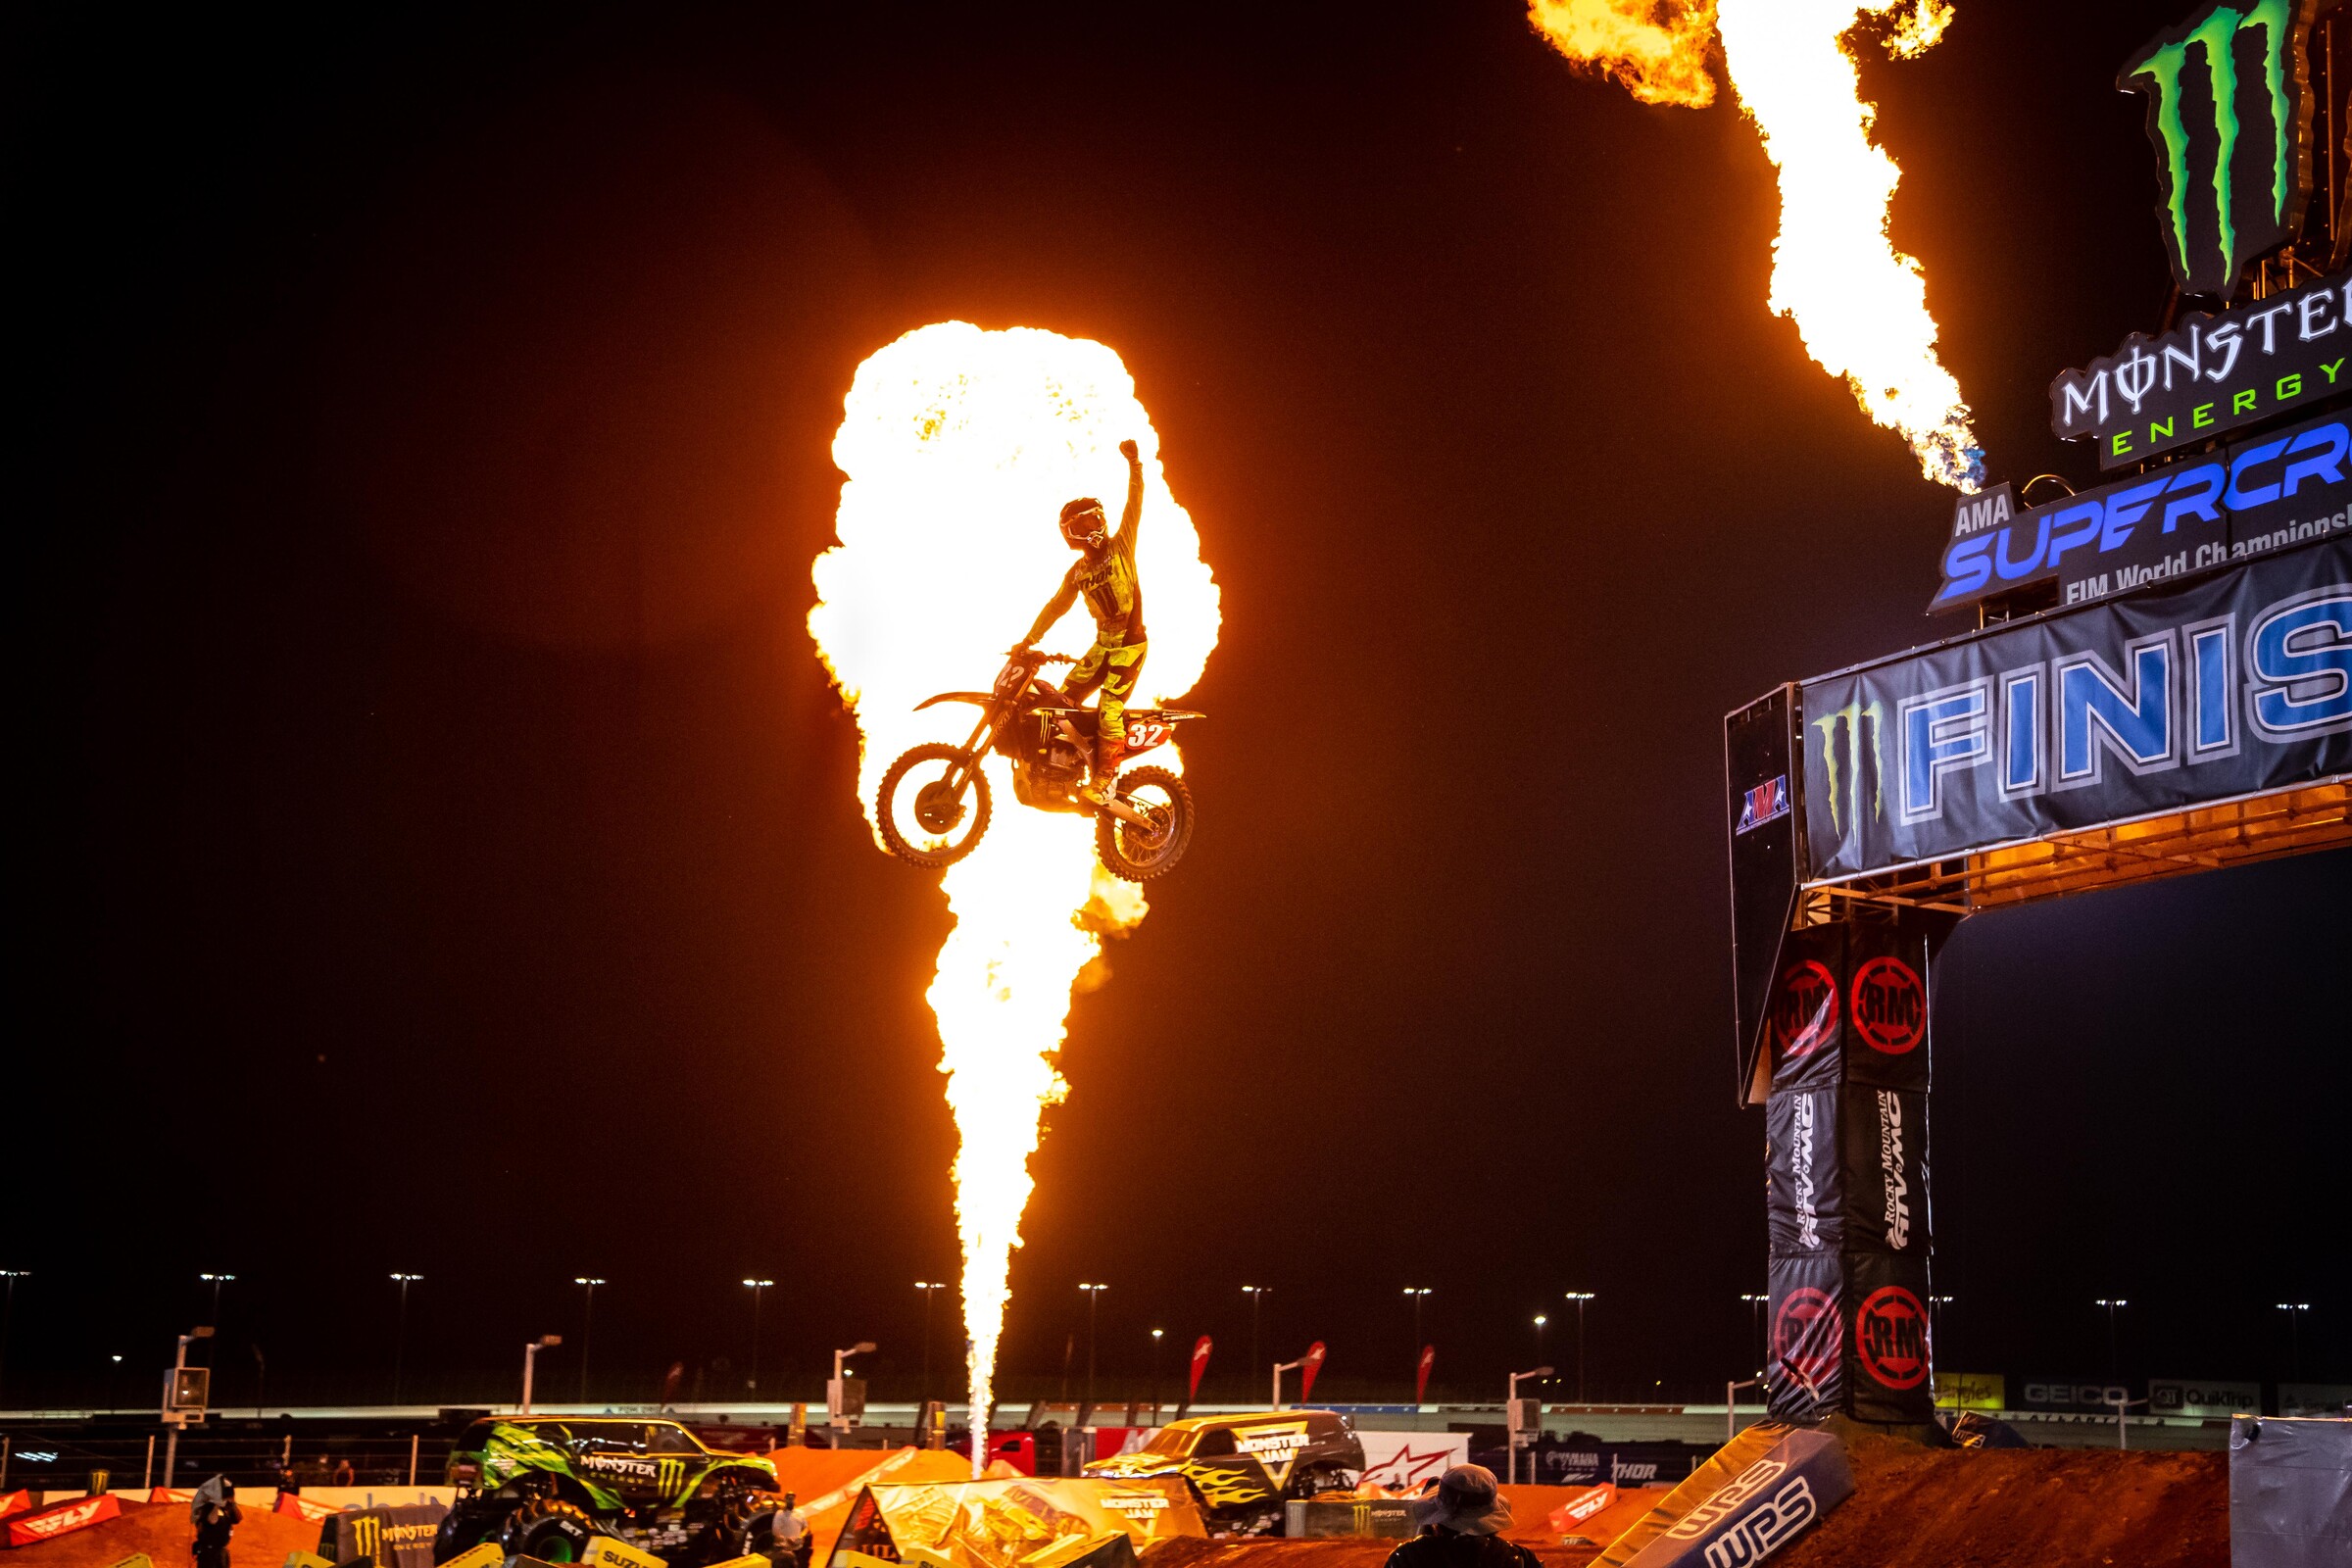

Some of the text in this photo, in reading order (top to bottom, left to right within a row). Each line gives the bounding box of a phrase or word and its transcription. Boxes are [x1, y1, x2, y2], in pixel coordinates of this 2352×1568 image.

[2112, 357, 2346, 457] ENERGY
[1936, 421, 2352, 601] SUPERCR
[1955, 493, 2010, 536] AMA
[1078, 564, 1113, 589] THOR
[2067, 573, 2109, 605] FIM
[2115, 550, 2187, 590] World
[1897, 582, 2352, 827] FINIS
[1127, 723, 1164, 748] 32
[1736, 774, 1789, 832] AMA
[1791, 1094, 1806, 1225] ROCKY MOUNTAIN
[1877, 1089, 1895, 1224] ROCKY MOUNTAIN
[2024, 1383, 2129, 1405] GEICO
[2185, 1389, 2254, 1409] QuikTrip
[1234, 1434, 1310, 1454] MONSTER
[1259, 1448, 1295, 1464] JAM
[579, 1454, 657, 1478] MONSTER
[1610, 1463, 1658, 1480] THOR
[1100, 1497, 1169, 1509] MONSTER
[1124, 1508, 1155, 1519] JAM
[1568, 1491, 1608, 1519] FLY
[1666, 1458, 1788, 1541] WPS
[24, 1500, 102, 1534] FLY
[1703, 1474, 1817, 1568] WPS
[380, 1523, 439, 1543] MONSTER
